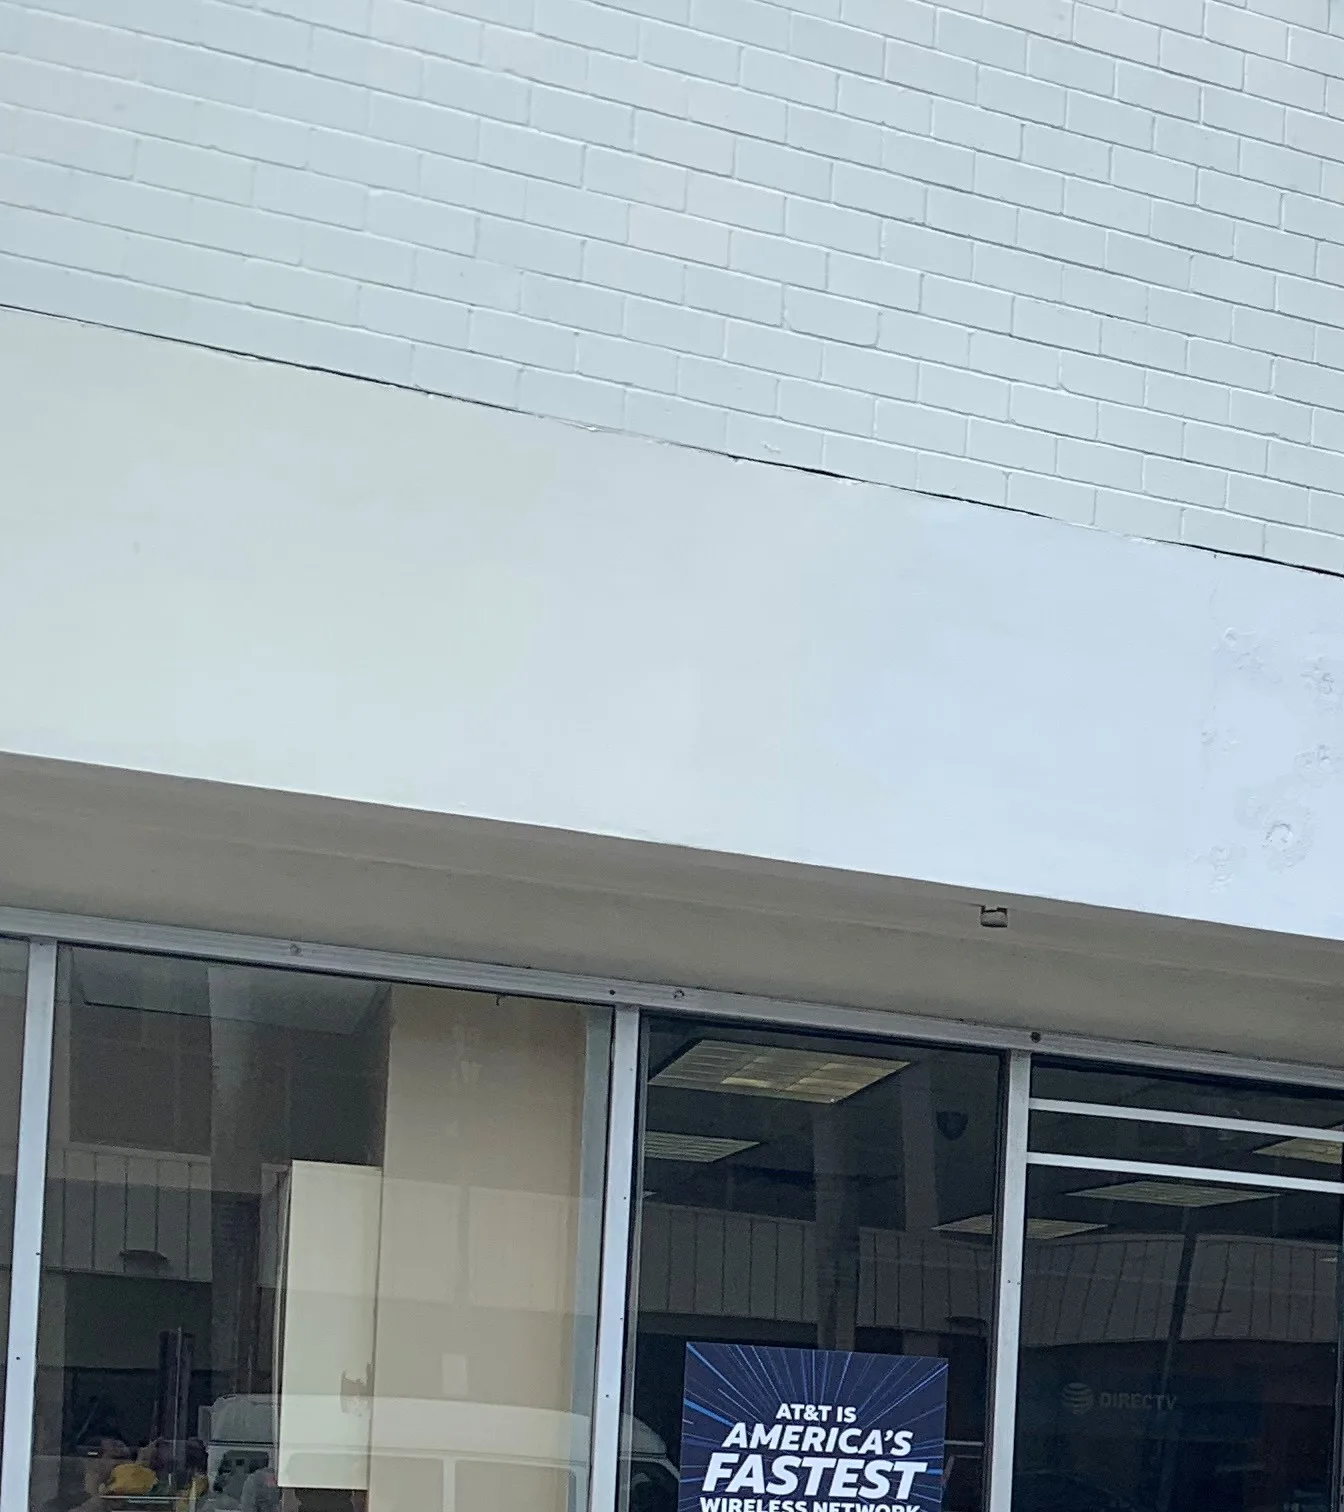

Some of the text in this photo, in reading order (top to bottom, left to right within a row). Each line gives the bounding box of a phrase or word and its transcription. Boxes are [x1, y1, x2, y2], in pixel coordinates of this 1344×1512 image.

[776, 1403, 857, 1423] AT&T IS
[722, 1422, 914, 1456] AMERICA'S
[702, 1453, 928, 1500] FASTEST
